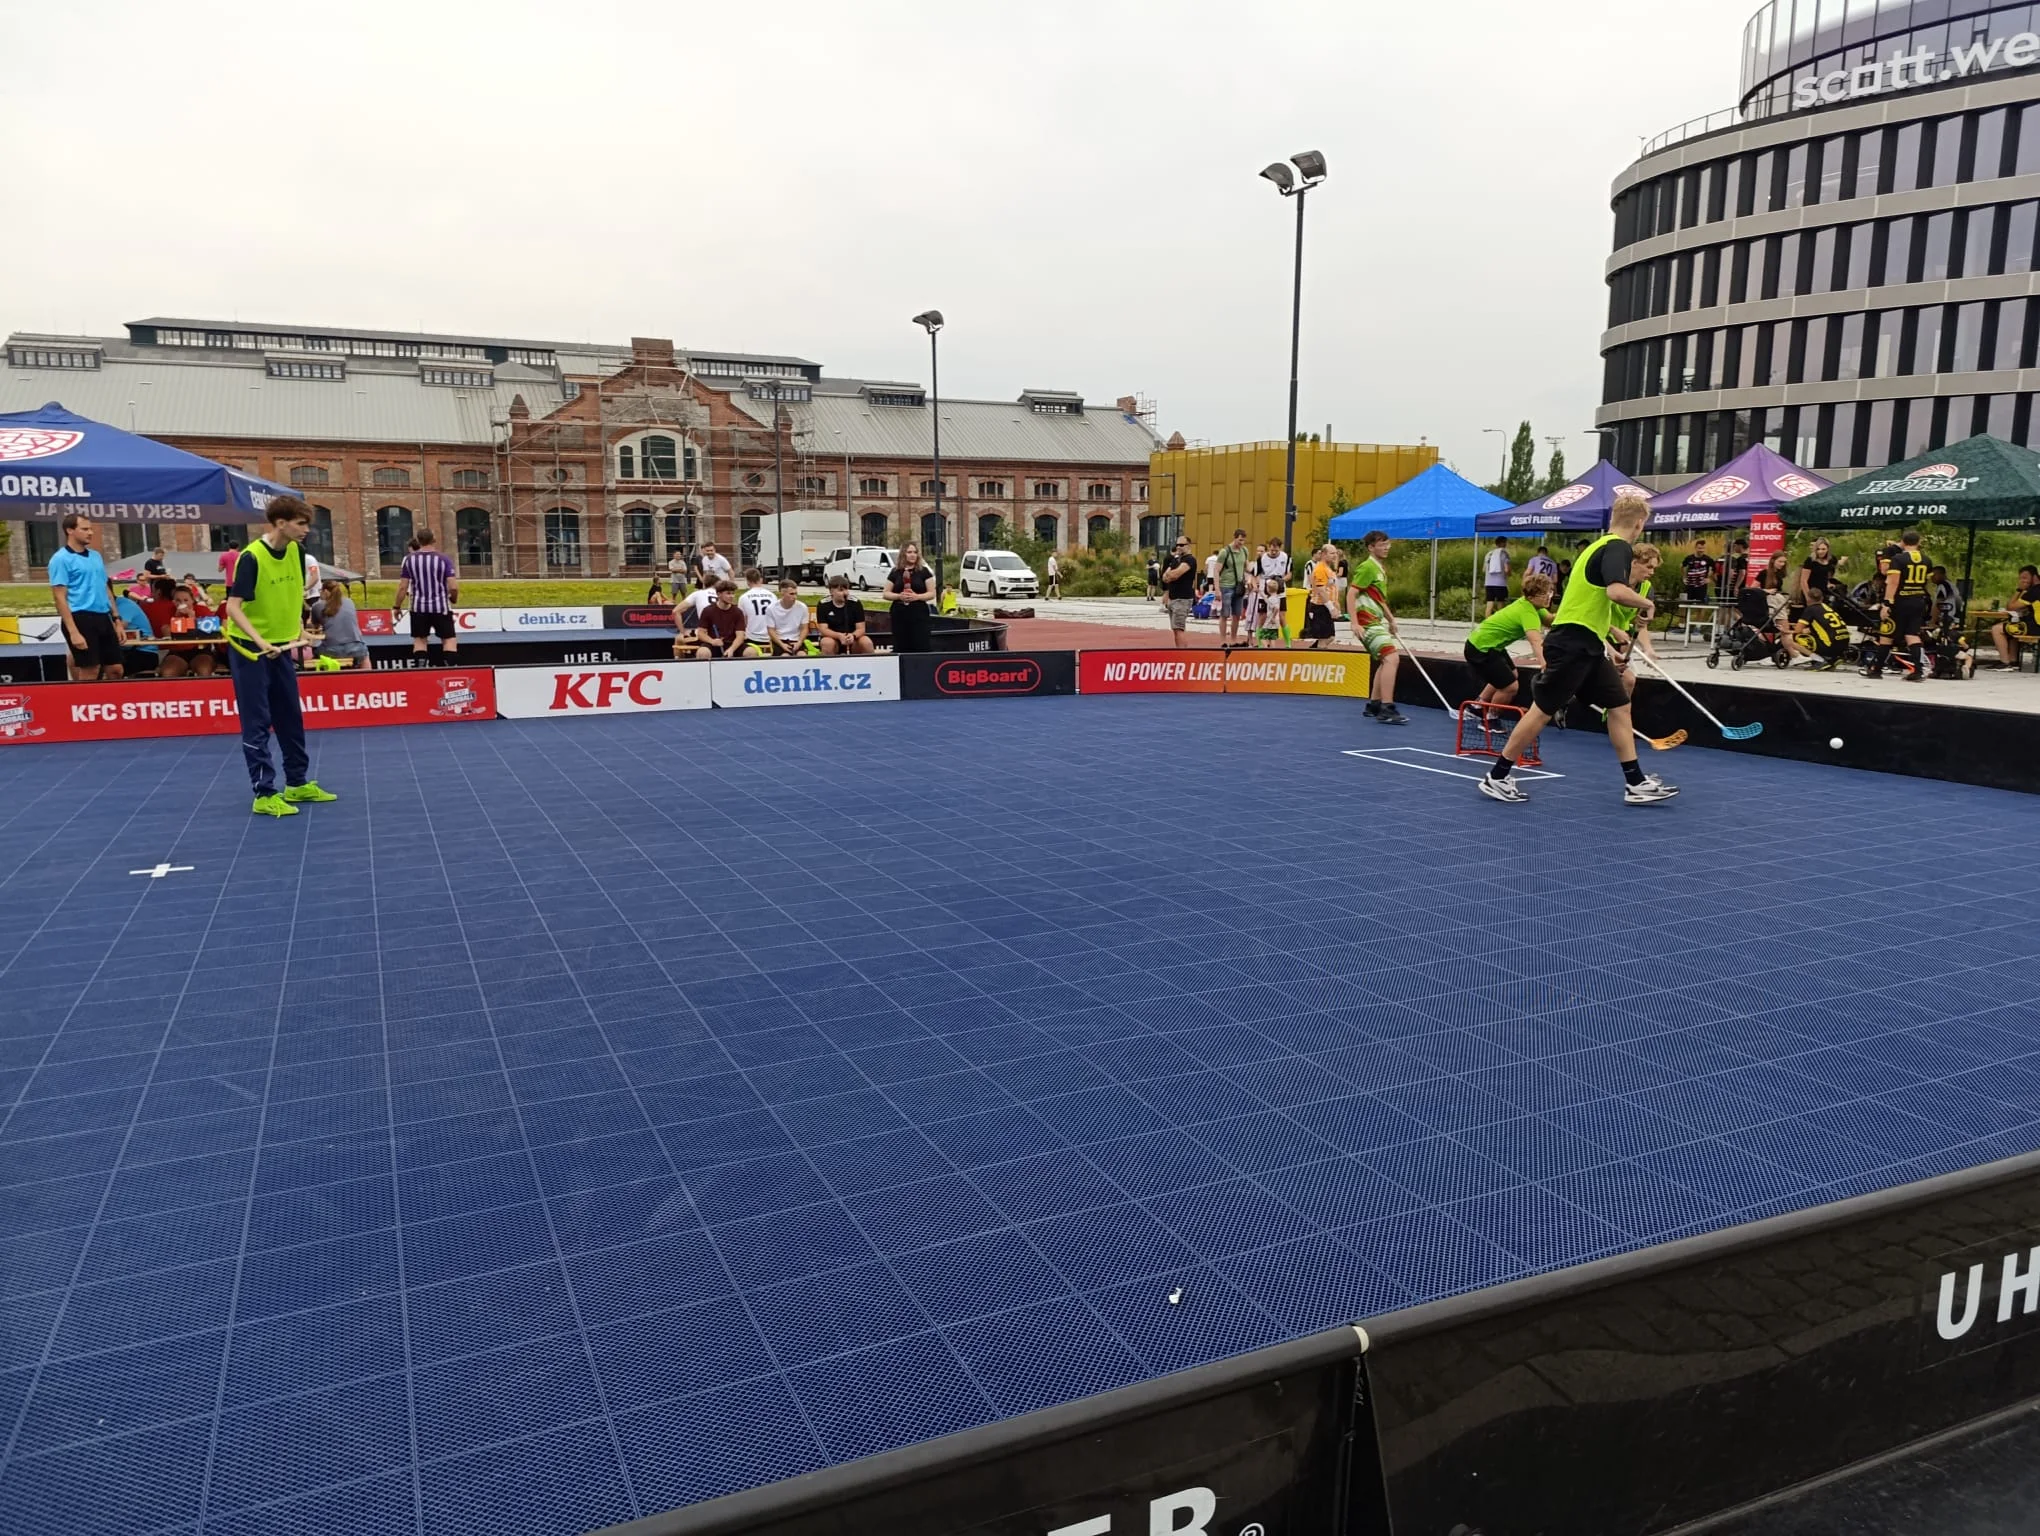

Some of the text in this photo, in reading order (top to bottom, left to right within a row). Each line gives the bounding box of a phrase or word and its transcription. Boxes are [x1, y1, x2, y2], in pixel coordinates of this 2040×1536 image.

[0, 475, 91, 497] ORBAL
[1857, 477, 1967, 494] HOLBA
[1840, 504, 1948, 518] RYZÍ PIVO Z HOR
[1763, 522, 1783, 531] KFC
[1540, 561, 1553, 577] 20
[1904, 565, 1927, 584] 10
[751, 599, 771, 616] 12
[743, 668, 872, 694] deník.cz
[947, 669, 1028, 687] BigBoard
[1104, 662, 1346, 684] NO POWER LIKE WOMEN POWER
[549, 670, 663, 710] KFC
[72, 703, 117, 722] KFC
[121, 700, 204, 721] STREET
[332, 691, 408, 712] LEAGUE
